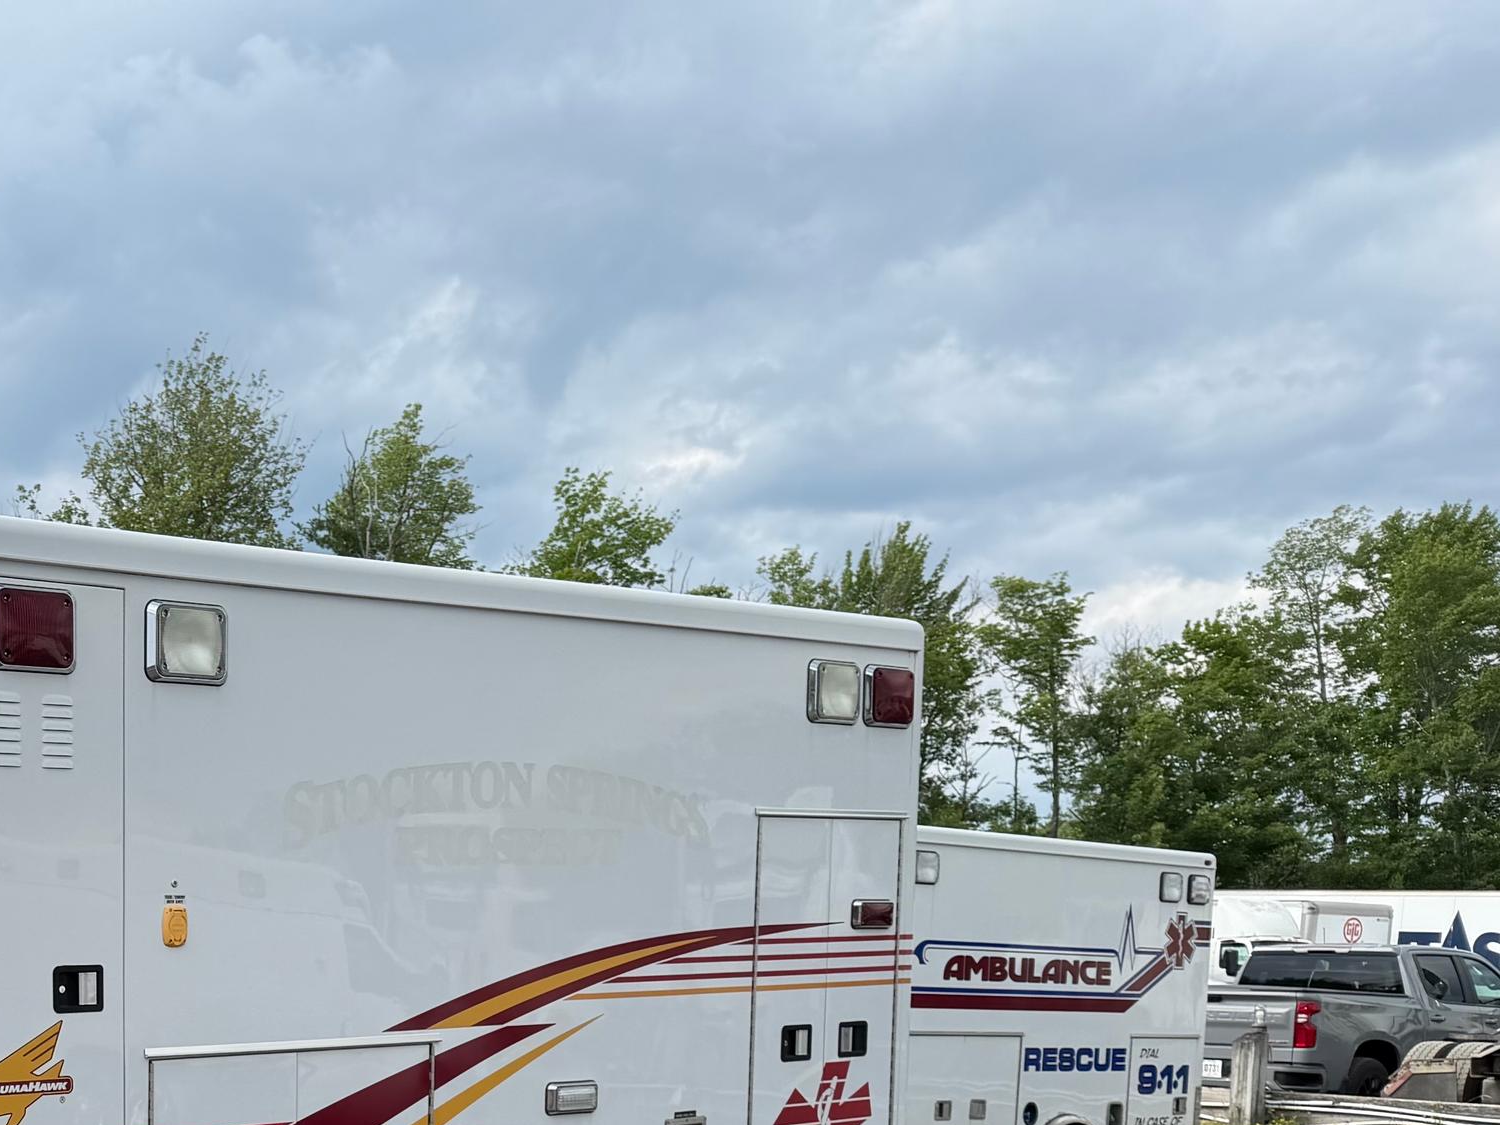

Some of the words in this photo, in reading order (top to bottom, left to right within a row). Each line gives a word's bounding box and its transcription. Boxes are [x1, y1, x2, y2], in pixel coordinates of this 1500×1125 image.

[282, 761, 536, 850] STOCKTON
[547, 763, 711, 848] SPRINGS
[943, 955, 1112, 986] AMBULANCE
[1024, 1048, 1127, 1072] RESCUE
[1140, 1048, 1159, 1059] DIAL
